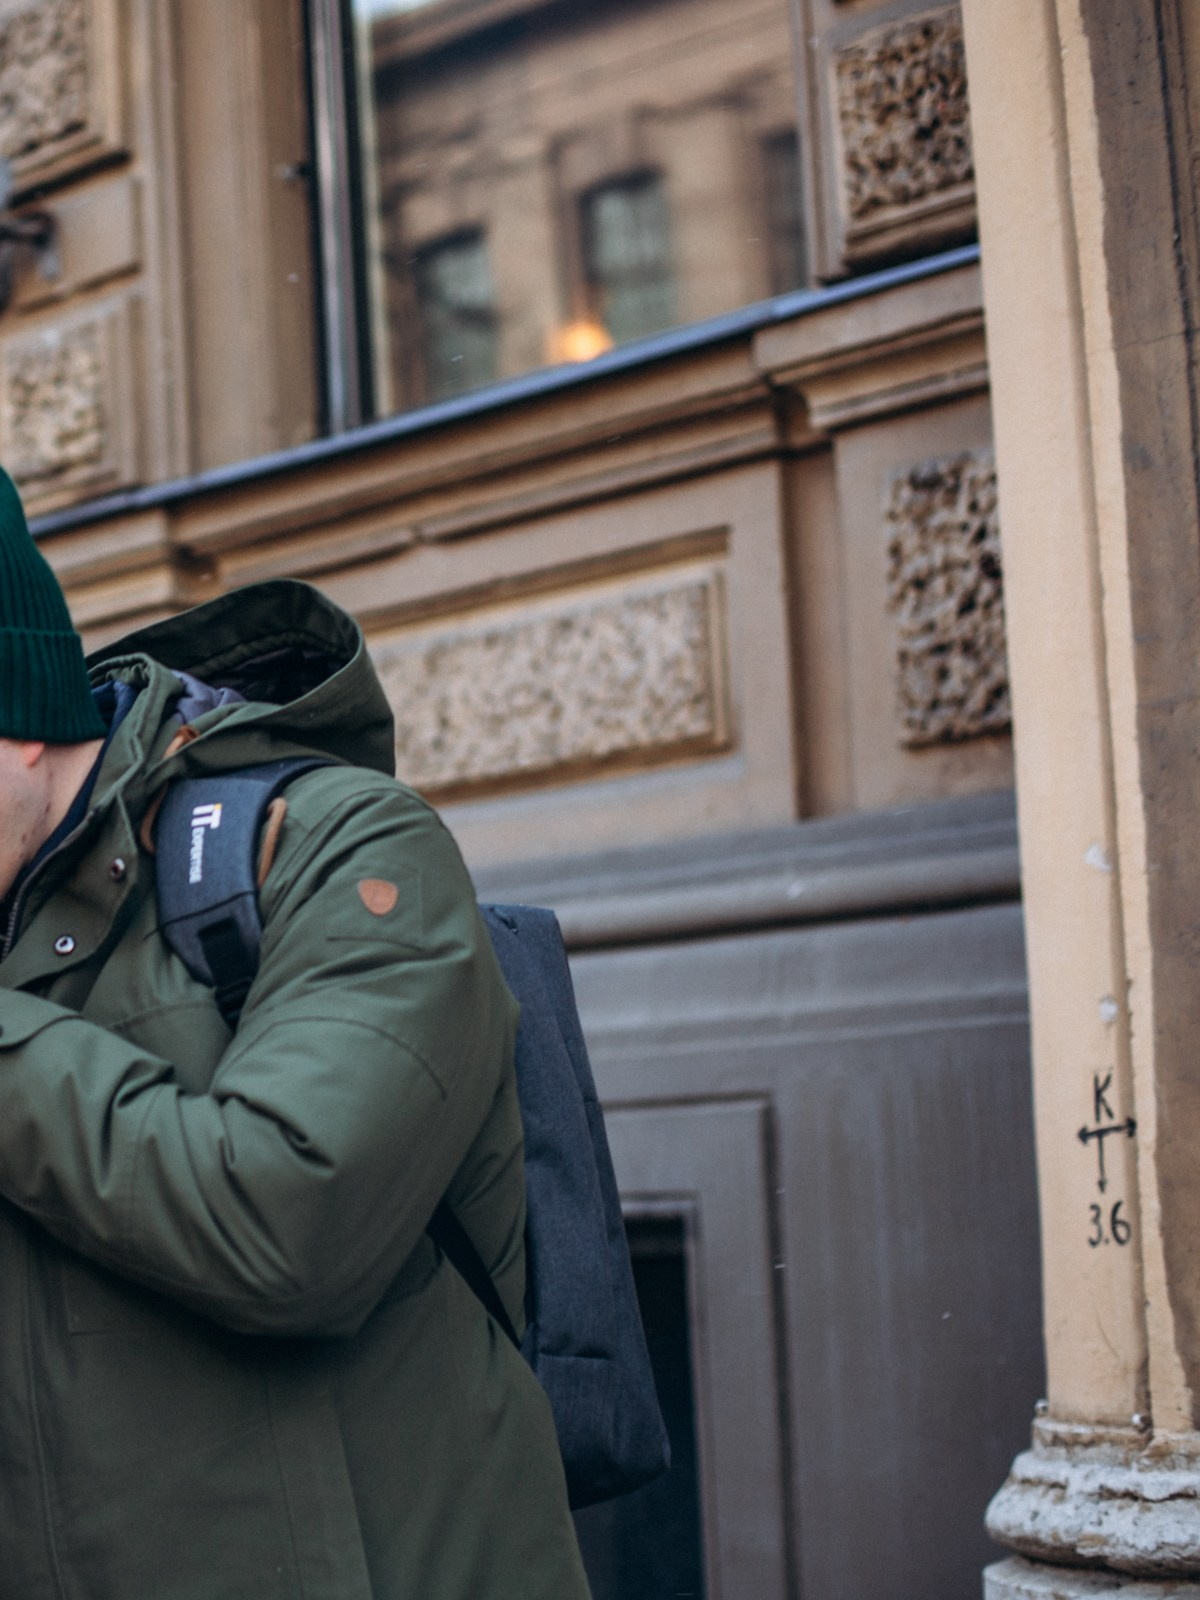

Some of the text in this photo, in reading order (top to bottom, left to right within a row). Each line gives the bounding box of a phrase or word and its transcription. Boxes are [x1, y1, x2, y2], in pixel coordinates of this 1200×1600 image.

[191, 803, 222, 829] IT
[1093, 1069, 1115, 1123] K
[1087, 1200, 1132, 1247] 3.6
